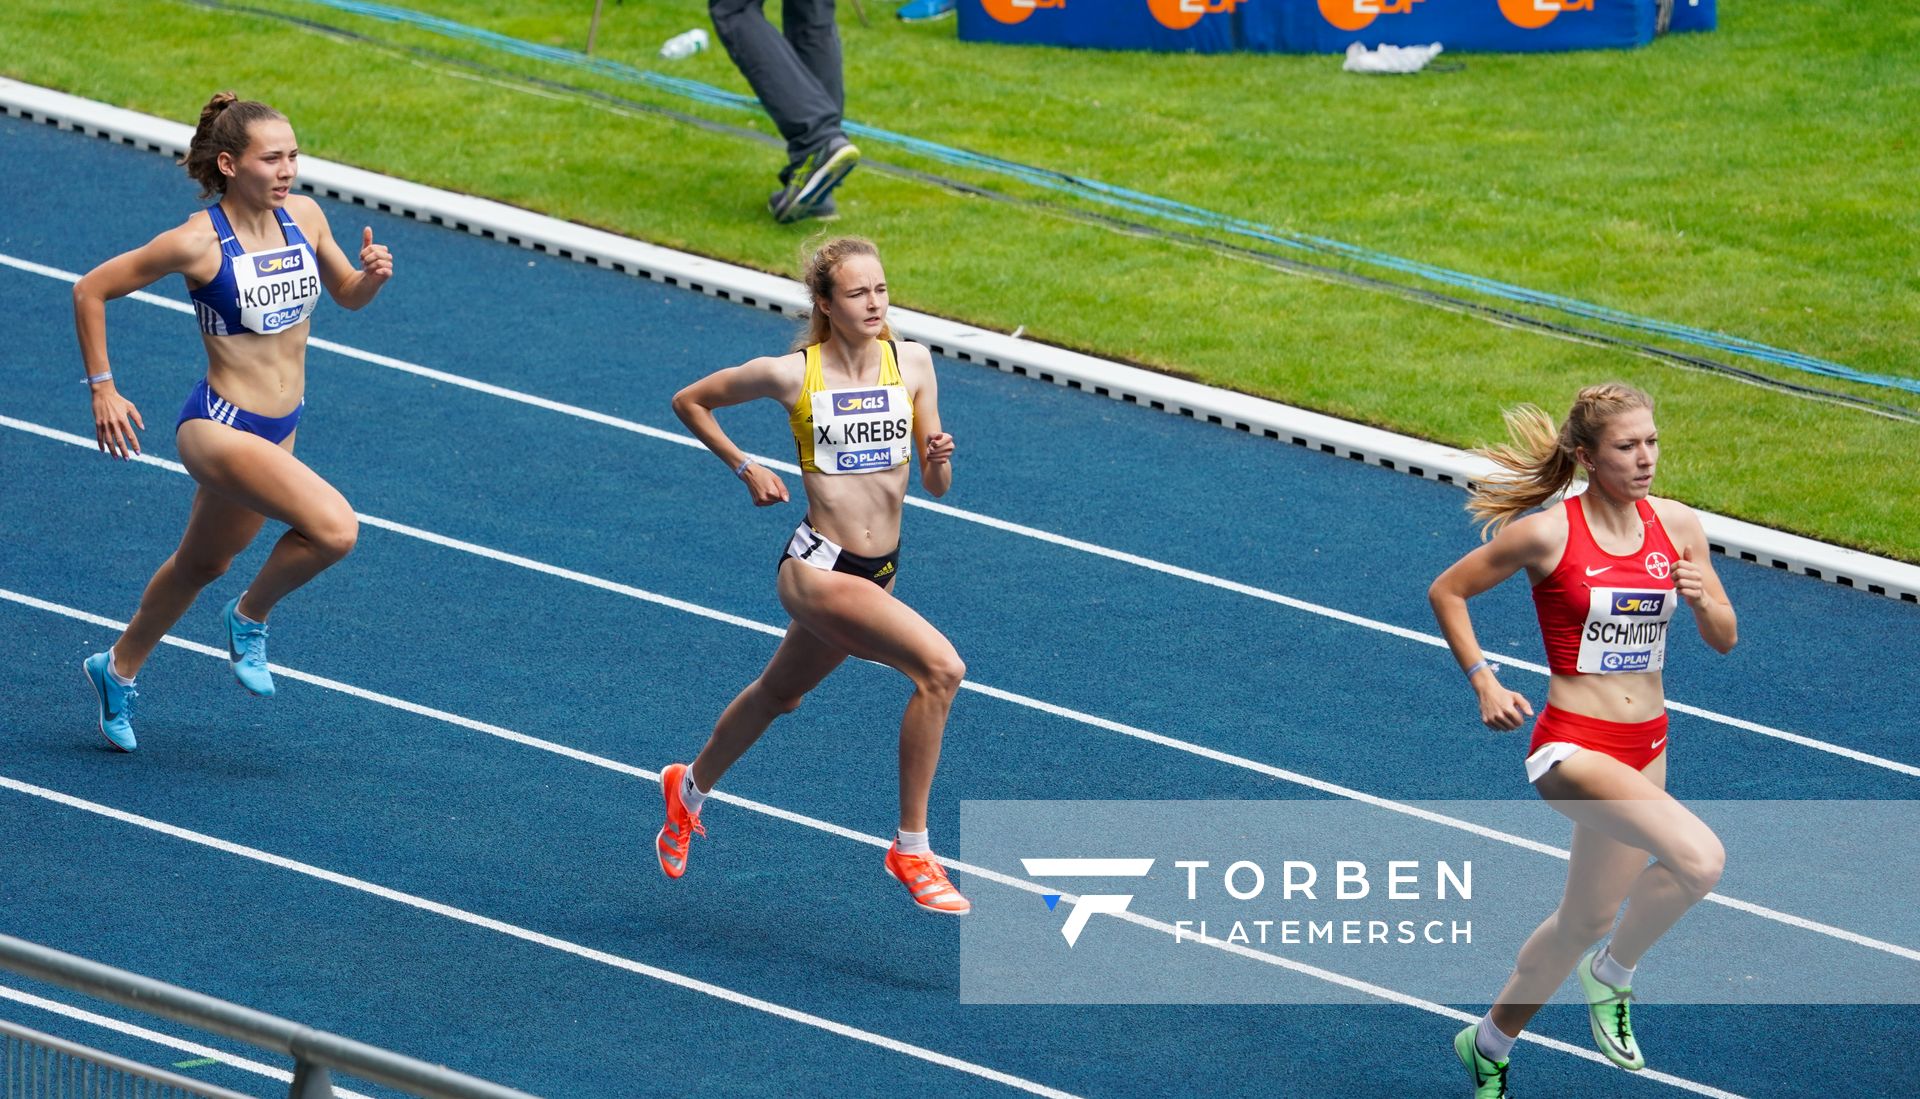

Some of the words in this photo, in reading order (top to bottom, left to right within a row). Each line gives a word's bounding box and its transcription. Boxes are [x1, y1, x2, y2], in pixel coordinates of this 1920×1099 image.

[282, 255, 300, 269] GLS
[244, 276, 318, 308] KOPPLER
[280, 307, 302, 320] PLAN
[862, 396, 884, 410] GLS
[818, 425, 837, 445] X.
[844, 418, 907, 444] KREBS
[860, 451, 889, 462] PLAN
[1639, 599, 1660, 612] GLS
[1586, 620, 1667, 645] SCHMIDT
[1623, 654, 1649, 665] PLAN
